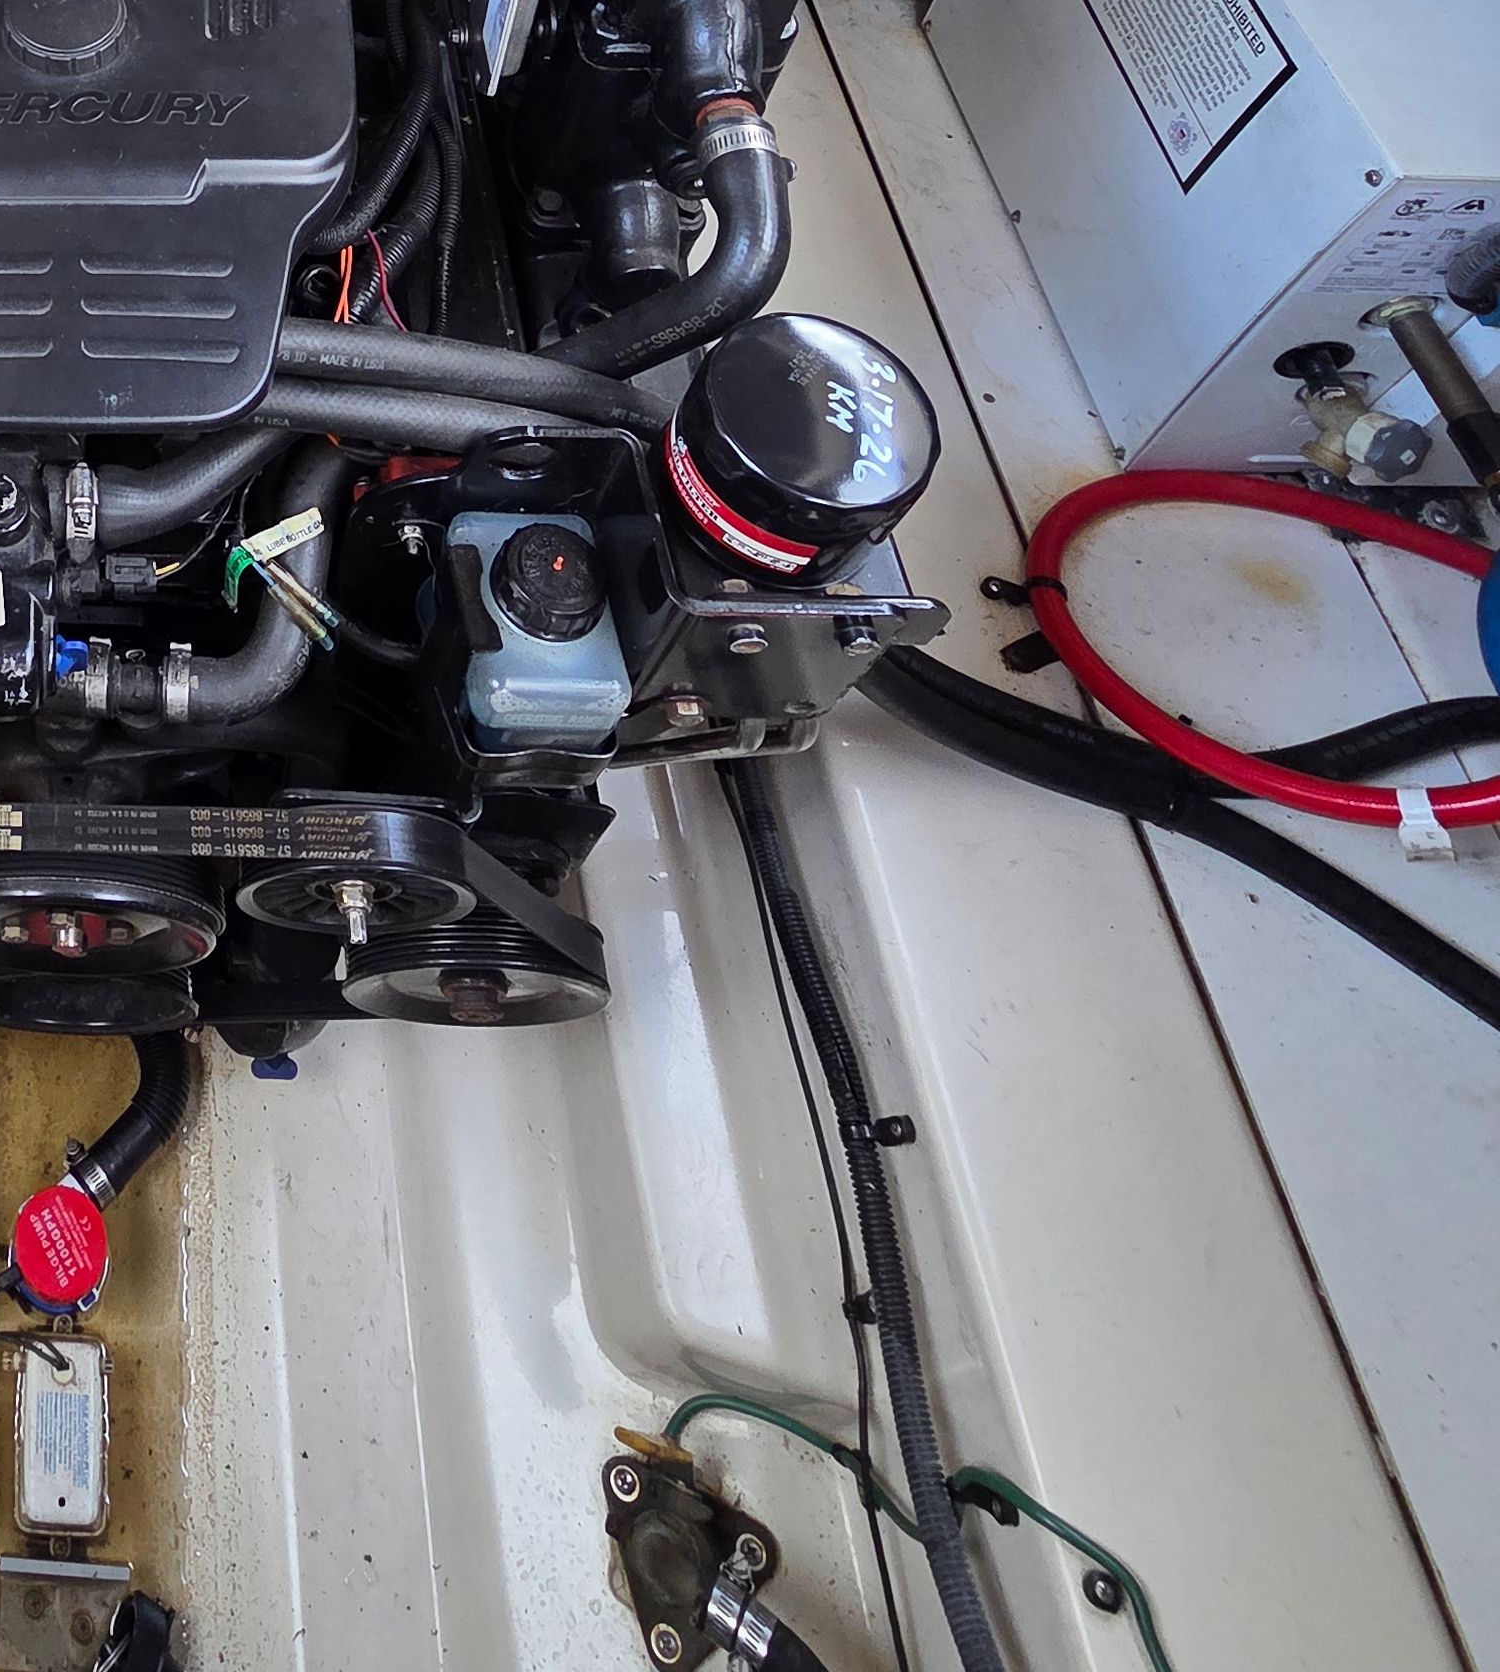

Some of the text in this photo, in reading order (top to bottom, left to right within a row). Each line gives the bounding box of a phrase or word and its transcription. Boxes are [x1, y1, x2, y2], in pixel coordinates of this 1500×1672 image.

[319, 354, 349, 367] MADE
[352, 357, 363, 368] IN
[364, 359, 385, 370] USA
[826, 379, 858, 434] KM
[296, 813, 371, 826] MERCURY
[299, 849, 374, 860] MERCURY
[30, 1213, 69, 1290] BILGE PUMP
[41, 1210, 79, 1278] 1100GPH
